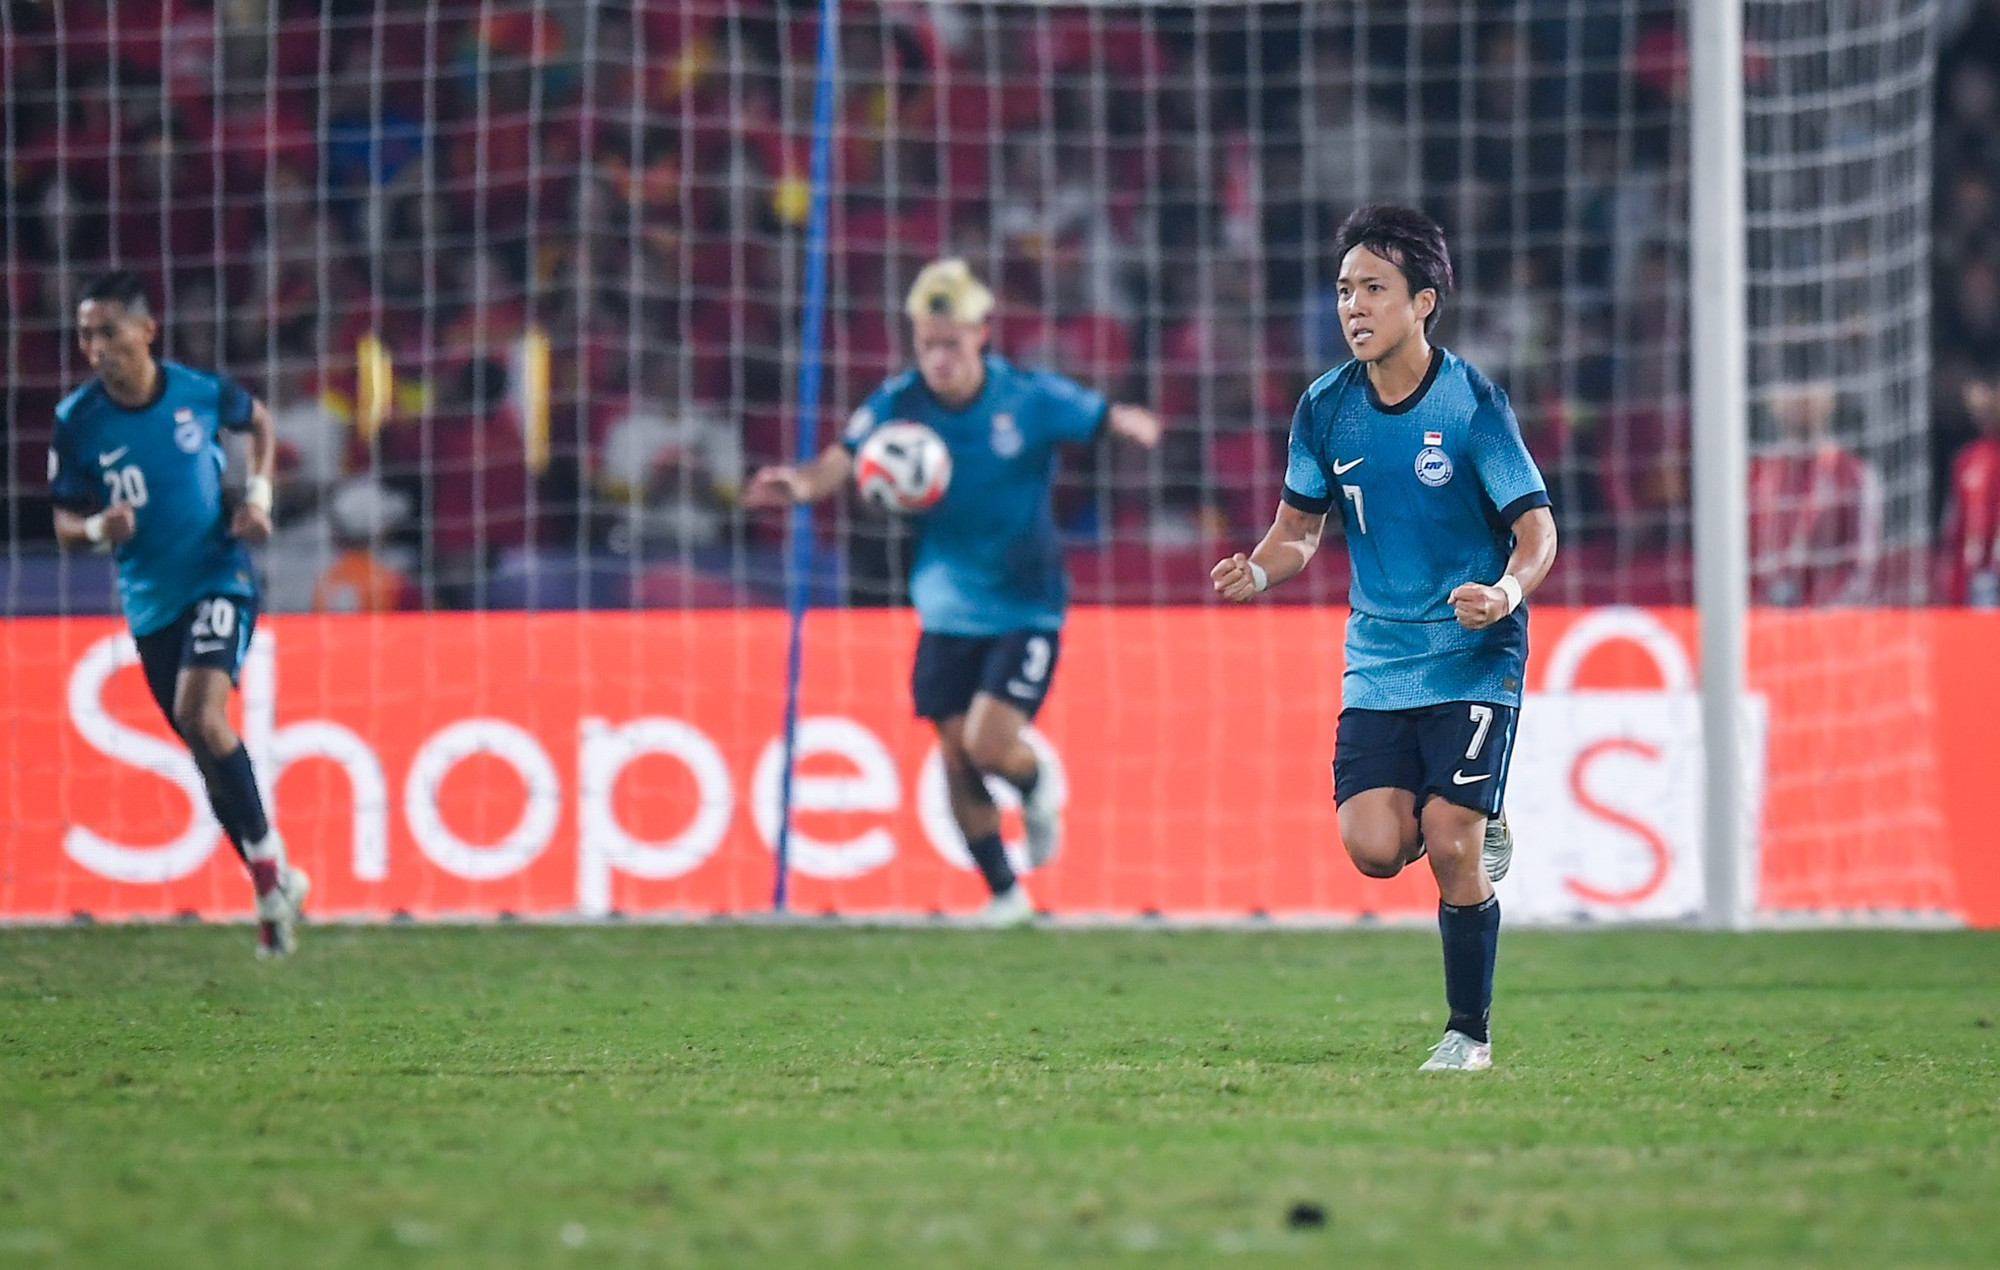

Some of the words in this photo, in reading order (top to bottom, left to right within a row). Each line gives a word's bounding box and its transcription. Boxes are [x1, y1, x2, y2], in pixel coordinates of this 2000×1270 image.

[104, 465, 148, 508] 20
[1342, 484, 1367, 534] 7
[191, 598, 235, 638] 20
[1021, 637, 1050, 682] 3
[1466, 704, 1494, 760] 7
[1564, 737, 1671, 906] S
